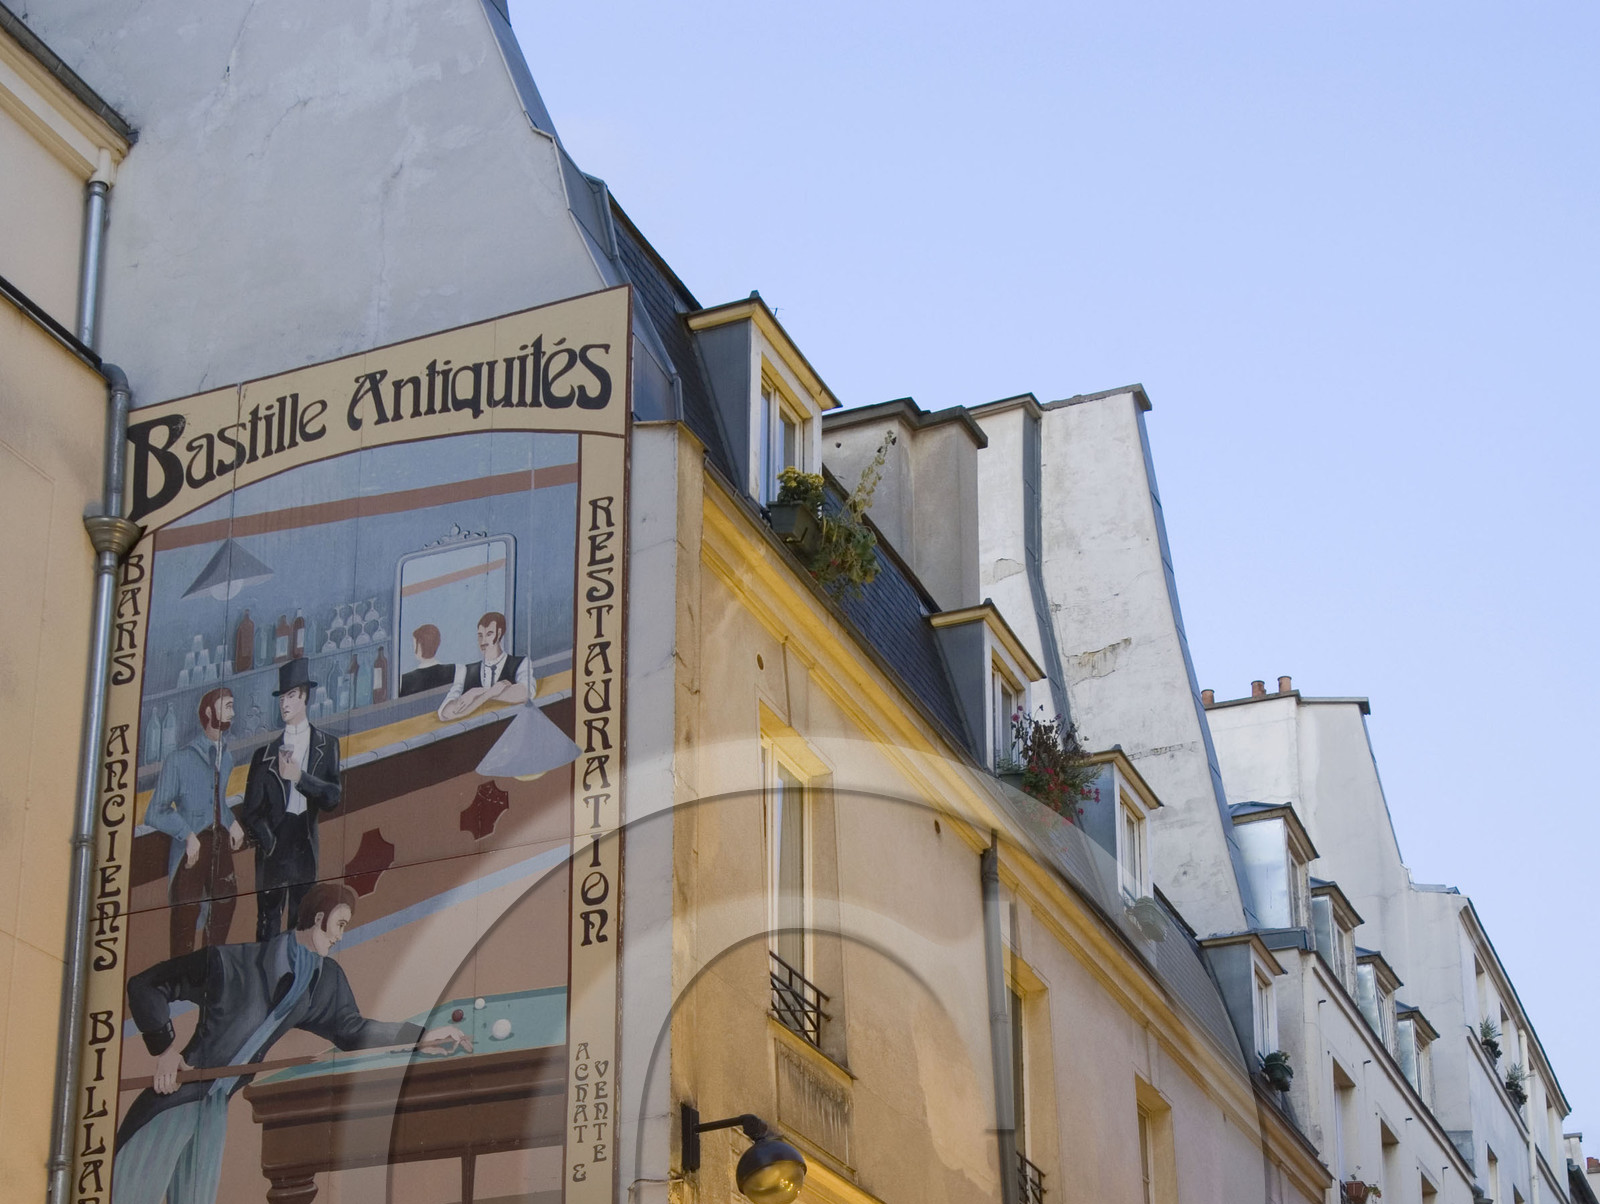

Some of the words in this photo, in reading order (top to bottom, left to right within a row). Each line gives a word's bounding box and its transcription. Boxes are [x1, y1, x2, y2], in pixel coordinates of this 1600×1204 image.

[128, 393, 328, 519] Bastille
[347, 333, 613, 432] Antiquités
[111, 552, 146, 687] BARS
[579, 496, 616, 947] RESTAURATION
[92, 723, 130, 972] ANCIENS
[573, 1042, 590, 1144] ACHAT
[592, 1060, 609, 1163] VENTE
[572, 1163, 587, 1182] &
